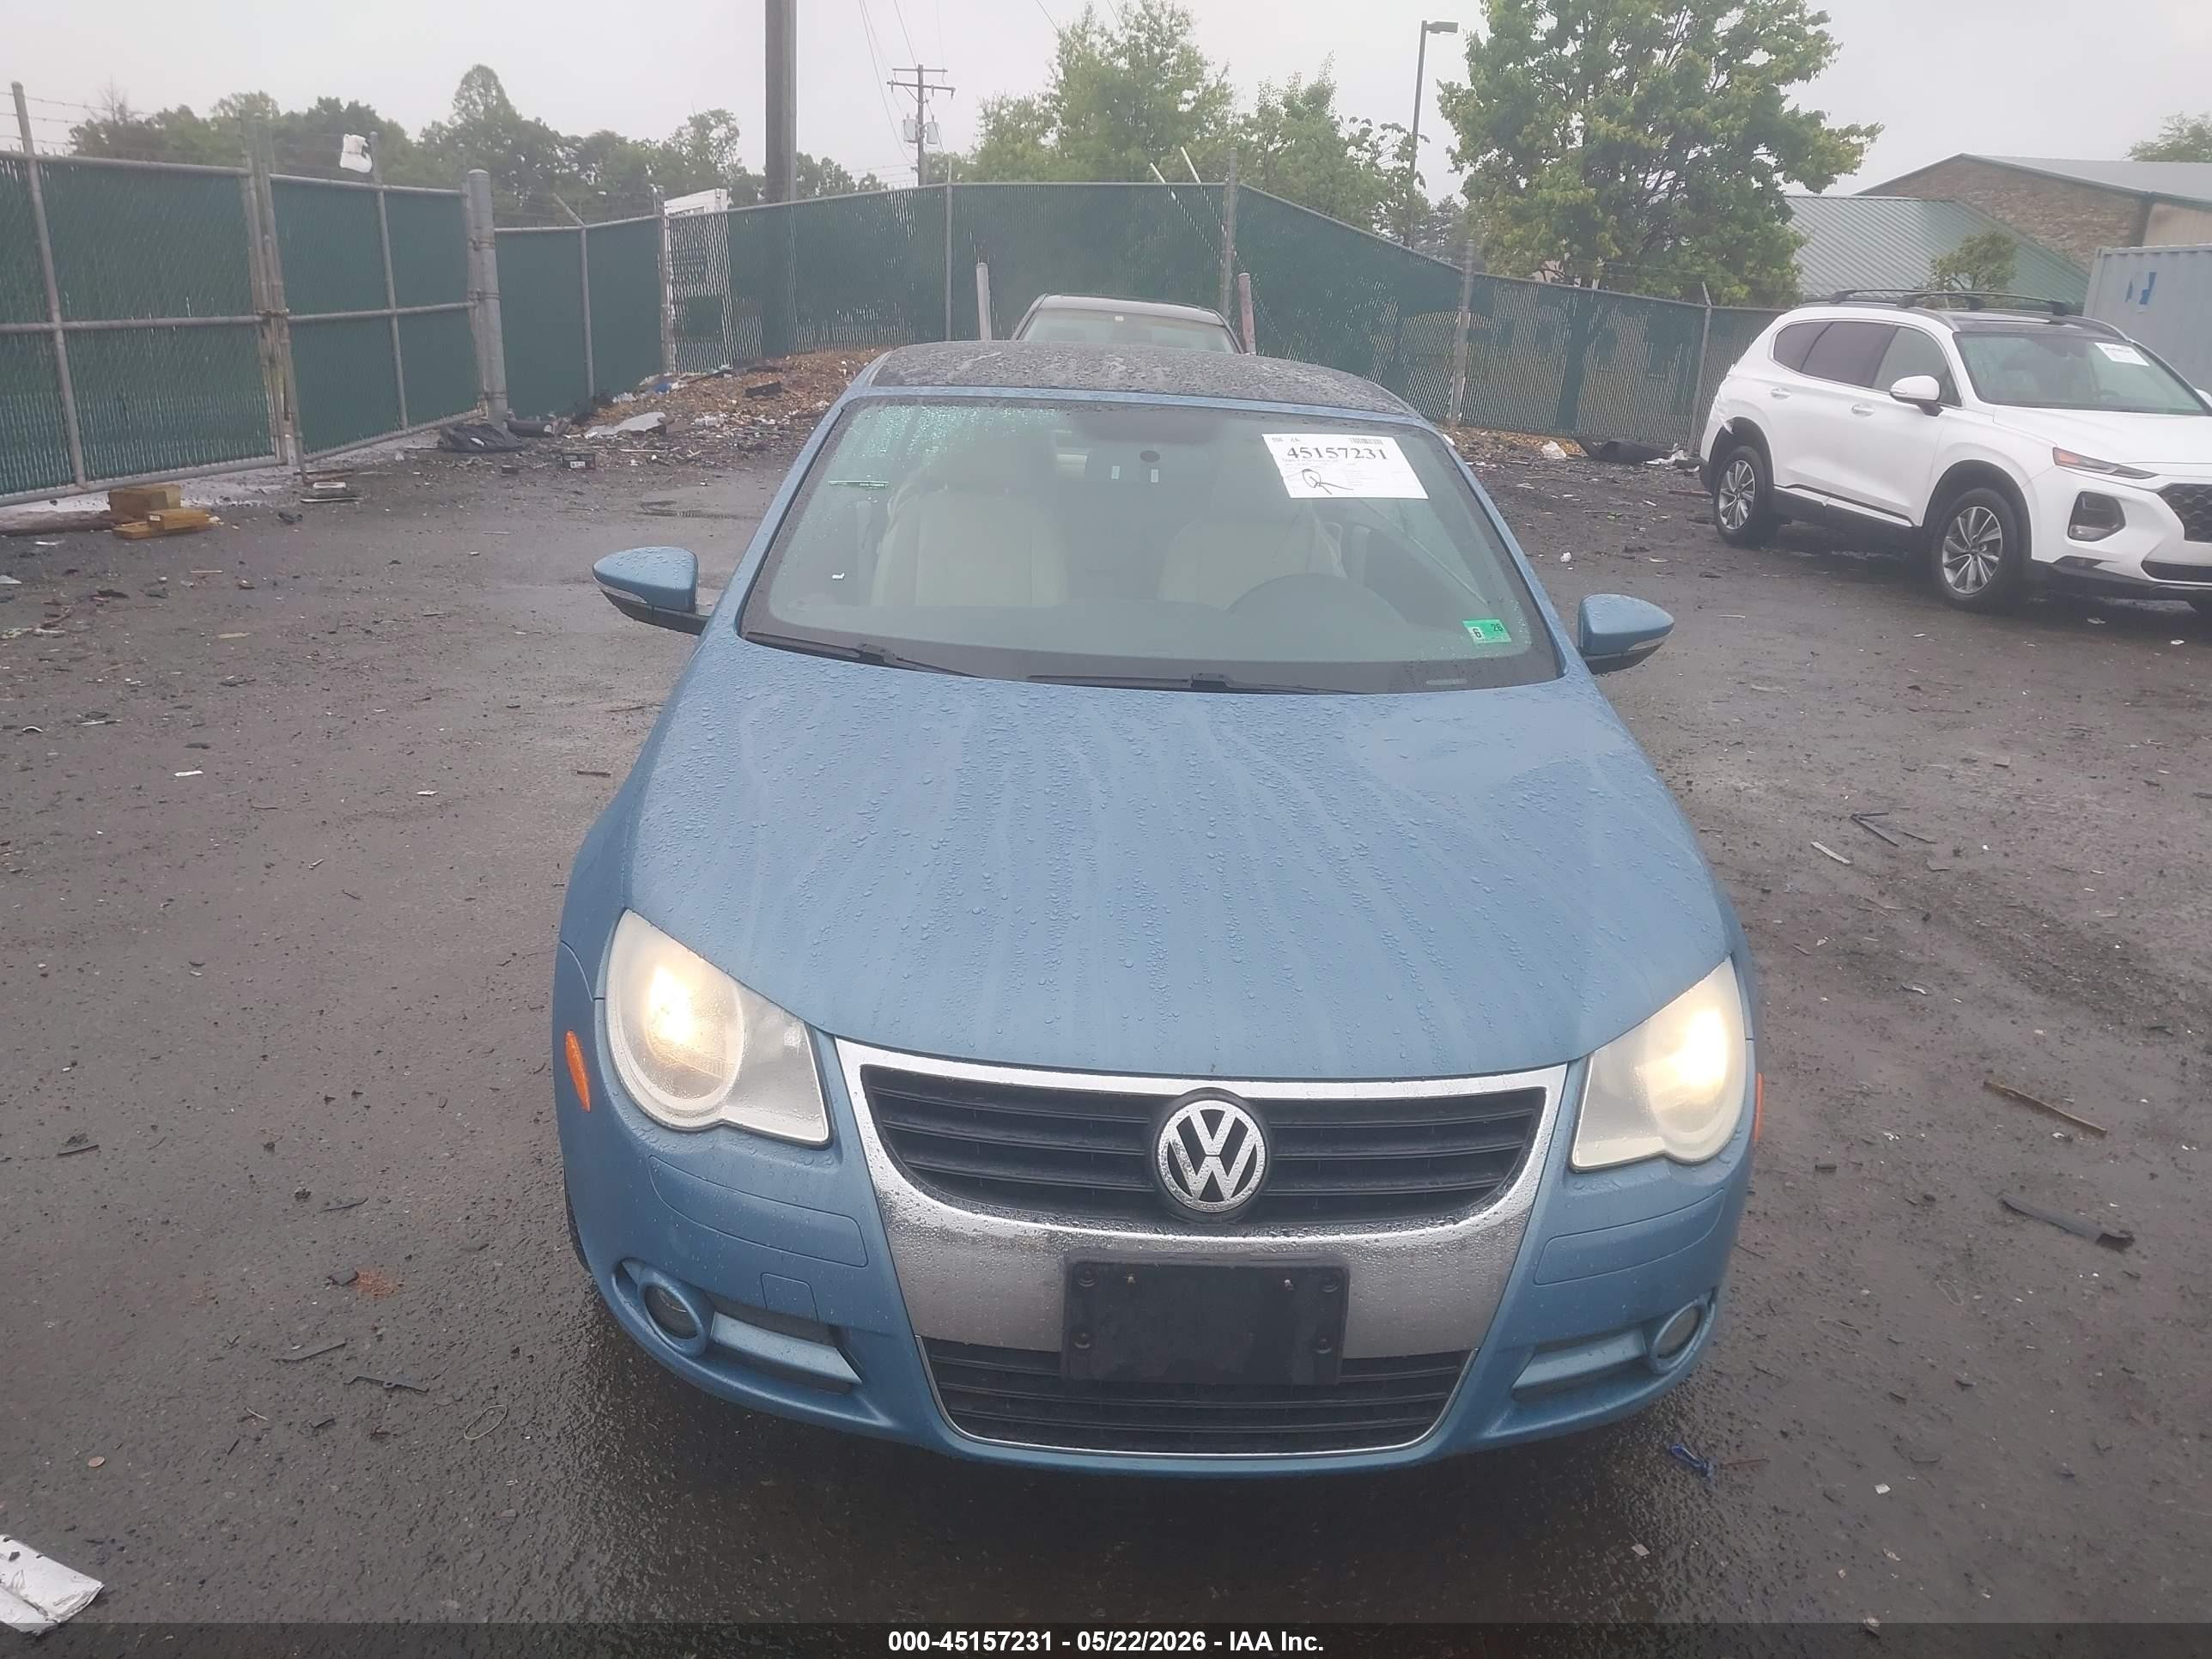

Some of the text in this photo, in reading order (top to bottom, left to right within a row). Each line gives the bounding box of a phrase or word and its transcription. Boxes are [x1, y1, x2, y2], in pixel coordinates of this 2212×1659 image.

[1286, 446, 1388, 460] 45157231
[1472, 628, 1482, 638] 6
[1490, 623, 1504, 632] 26
[1163, 1103, 1261, 1208] VW
